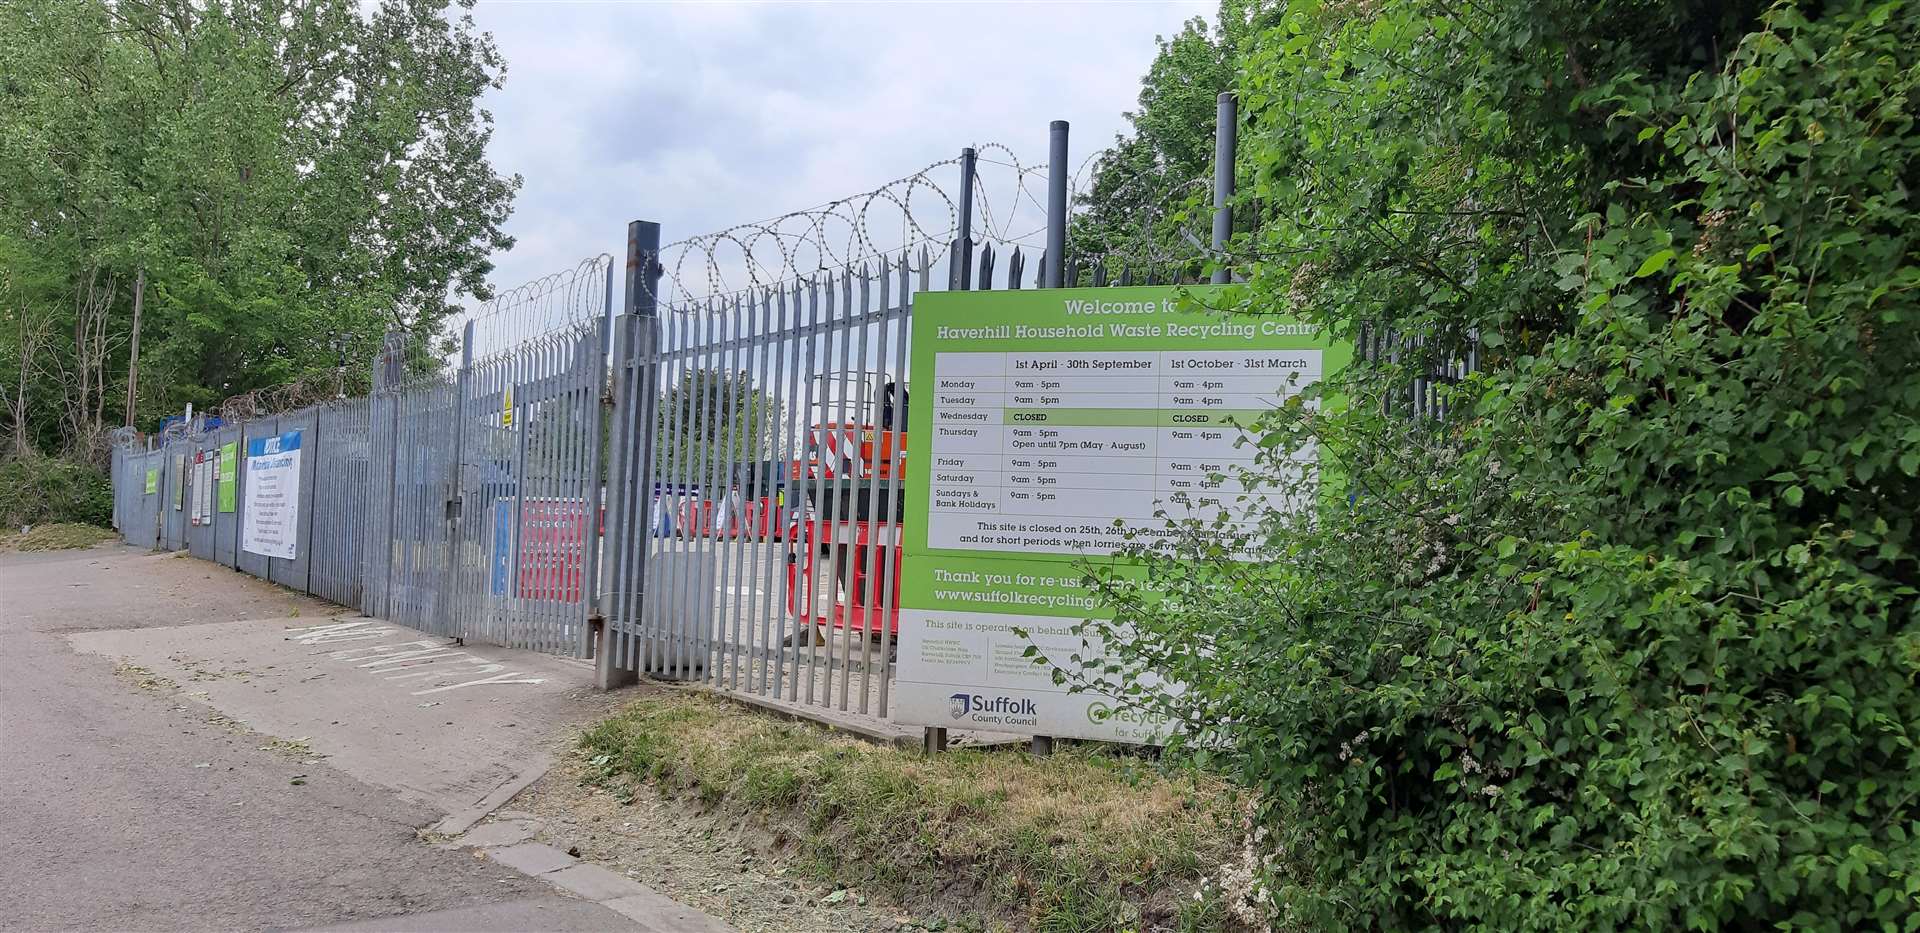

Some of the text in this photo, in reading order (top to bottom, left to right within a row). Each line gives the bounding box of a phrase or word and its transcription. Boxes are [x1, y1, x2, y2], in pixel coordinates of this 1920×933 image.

[1065, 298, 1156, 315] Welcome
[936, 325, 1010, 339] Haverhill
[1015, 323, 1104, 338] Household
[1109, 323, 1161, 337] Waste
[1166, 321, 1256, 340] Recycling
[1015, 360, 1028, 369] 1st
[1031, 359, 1058, 371] April
[1066, 359, 1089, 369] 30th
[1092, 359, 1152, 371] September
[1171, 359, 1186, 369] 1st
[1187, 358, 1234, 369] October
[1243, 358, 1265, 368] 31st
[1268, 357, 1307, 368] March
[940, 380, 975, 390] Monday
[1014, 380, 1034, 388] 9am
[1040, 380, 1060, 390] 5pm
[1173, 380, 1194, 389] 9am
[1202, 380, 1223, 391] 4pm
[940, 396, 975, 405] Tuesday
[1014, 396, 1033, 404] 9am
[1040, 395, 1060, 405] 5pm
[1173, 397, 1194, 405] 9am
[1201, 396, 1223, 406] 4pm
[939, 411, 988, 422] Wednesday
[1013, 413, 1047, 421] CLOSED
[1172, 414, 1209, 423] CLOSED
[938, 427, 978, 437] Thursday
[1012, 429, 1032, 437] 9am
[1039, 429, 1058, 439] 5pm
[1171, 431, 1193, 439] 9am
[1200, 431, 1222, 441] 4pm
[1012, 440, 1036, 450] Open
[1037, 440, 1057, 449] until
[1058, 441, 1078, 451] 7pm
[1079, 440, 1104, 451] (May
[1110, 441, 1146, 451] August)
[937, 458, 964, 467] Friday
[1011, 459, 1031, 468] 9am
[1037, 459, 1057, 469] 5pm
[1170, 462, 1192, 471] 9am
[1199, 462, 1221, 472] 4pm
[936, 474, 974, 483] Saturday
[1010, 475, 1030, 483] 9am
[1037, 475, 1057, 485] 5pm
[1170, 479, 1191, 487] 9am
[1198, 480, 1220, 490] 4pm
[935, 489, 979, 499] Sundays &
[1010, 492, 1029, 500] 9am
[1036, 491, 1056, 501] 5pm
[935, 499, 996, 510] Bank Holidays
[977, 521, 998, 531] This
[999, 522, 1017, 532] site
[1018, 523, 1027, 532] is
[1028, 523, 1062, 534] closed
[1064, 526, 1077, 534] on
[1079, 525, 1103, 536] 25th,
[1105, 526, 1127, 536] 26th
[1130, 527, 1184, 538] Decembe
[959, 534, 979, 544] and
[980, 534, 995, 544] for
[995, 535, 1021, 545] short
[1023, 537, 1061, 547] periods
[1063, 538, 1092, 548] when
[1094, 539, 1126, 549] lorries
[934, 569, 980, 583] Thank
[984, 573, 1012, 588] you
[1015, 573, 1036, 586] for
[1039, 575, 1099, 592] re-usig
[925, 619, 945, 629] This
[946, 620, 963, 630] site
[964, 622, 974, 630] is
[1037, 624, 1070, 636] behalf
[971, 694, 1037, 715] Suffolk
[971, 712, 1037, 727] County Council
